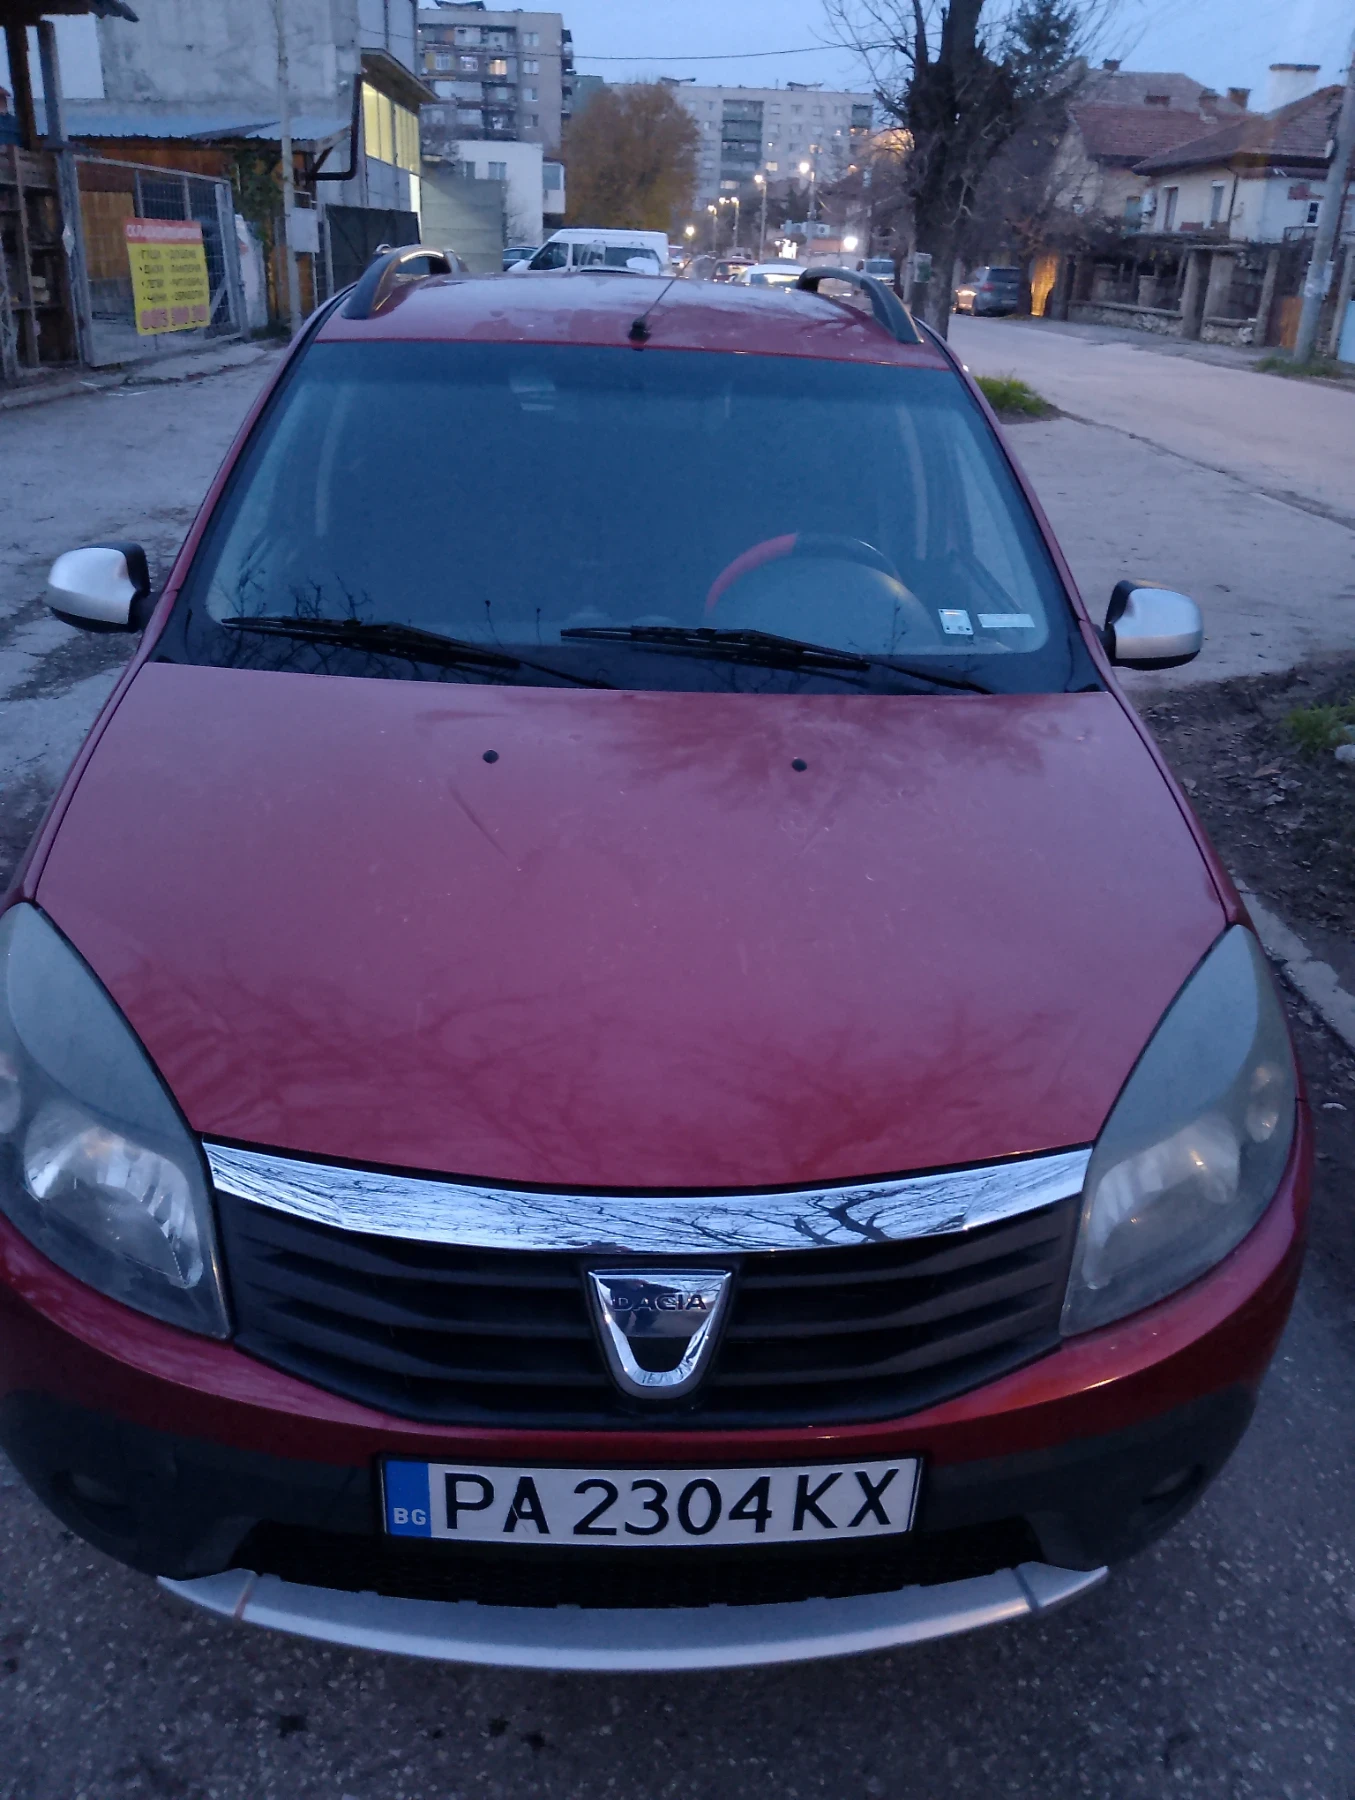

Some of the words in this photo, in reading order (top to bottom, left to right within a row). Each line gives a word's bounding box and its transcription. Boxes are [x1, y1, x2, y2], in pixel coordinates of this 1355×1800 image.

[612, 1293, 707, 1312] DACIA
[444, 1472, 551, 1534] PA
[572, 1476, 773, 1536] 2304
[792, 1468, 900, 1532] KX
[393, 1507, 427, 1526] BG
